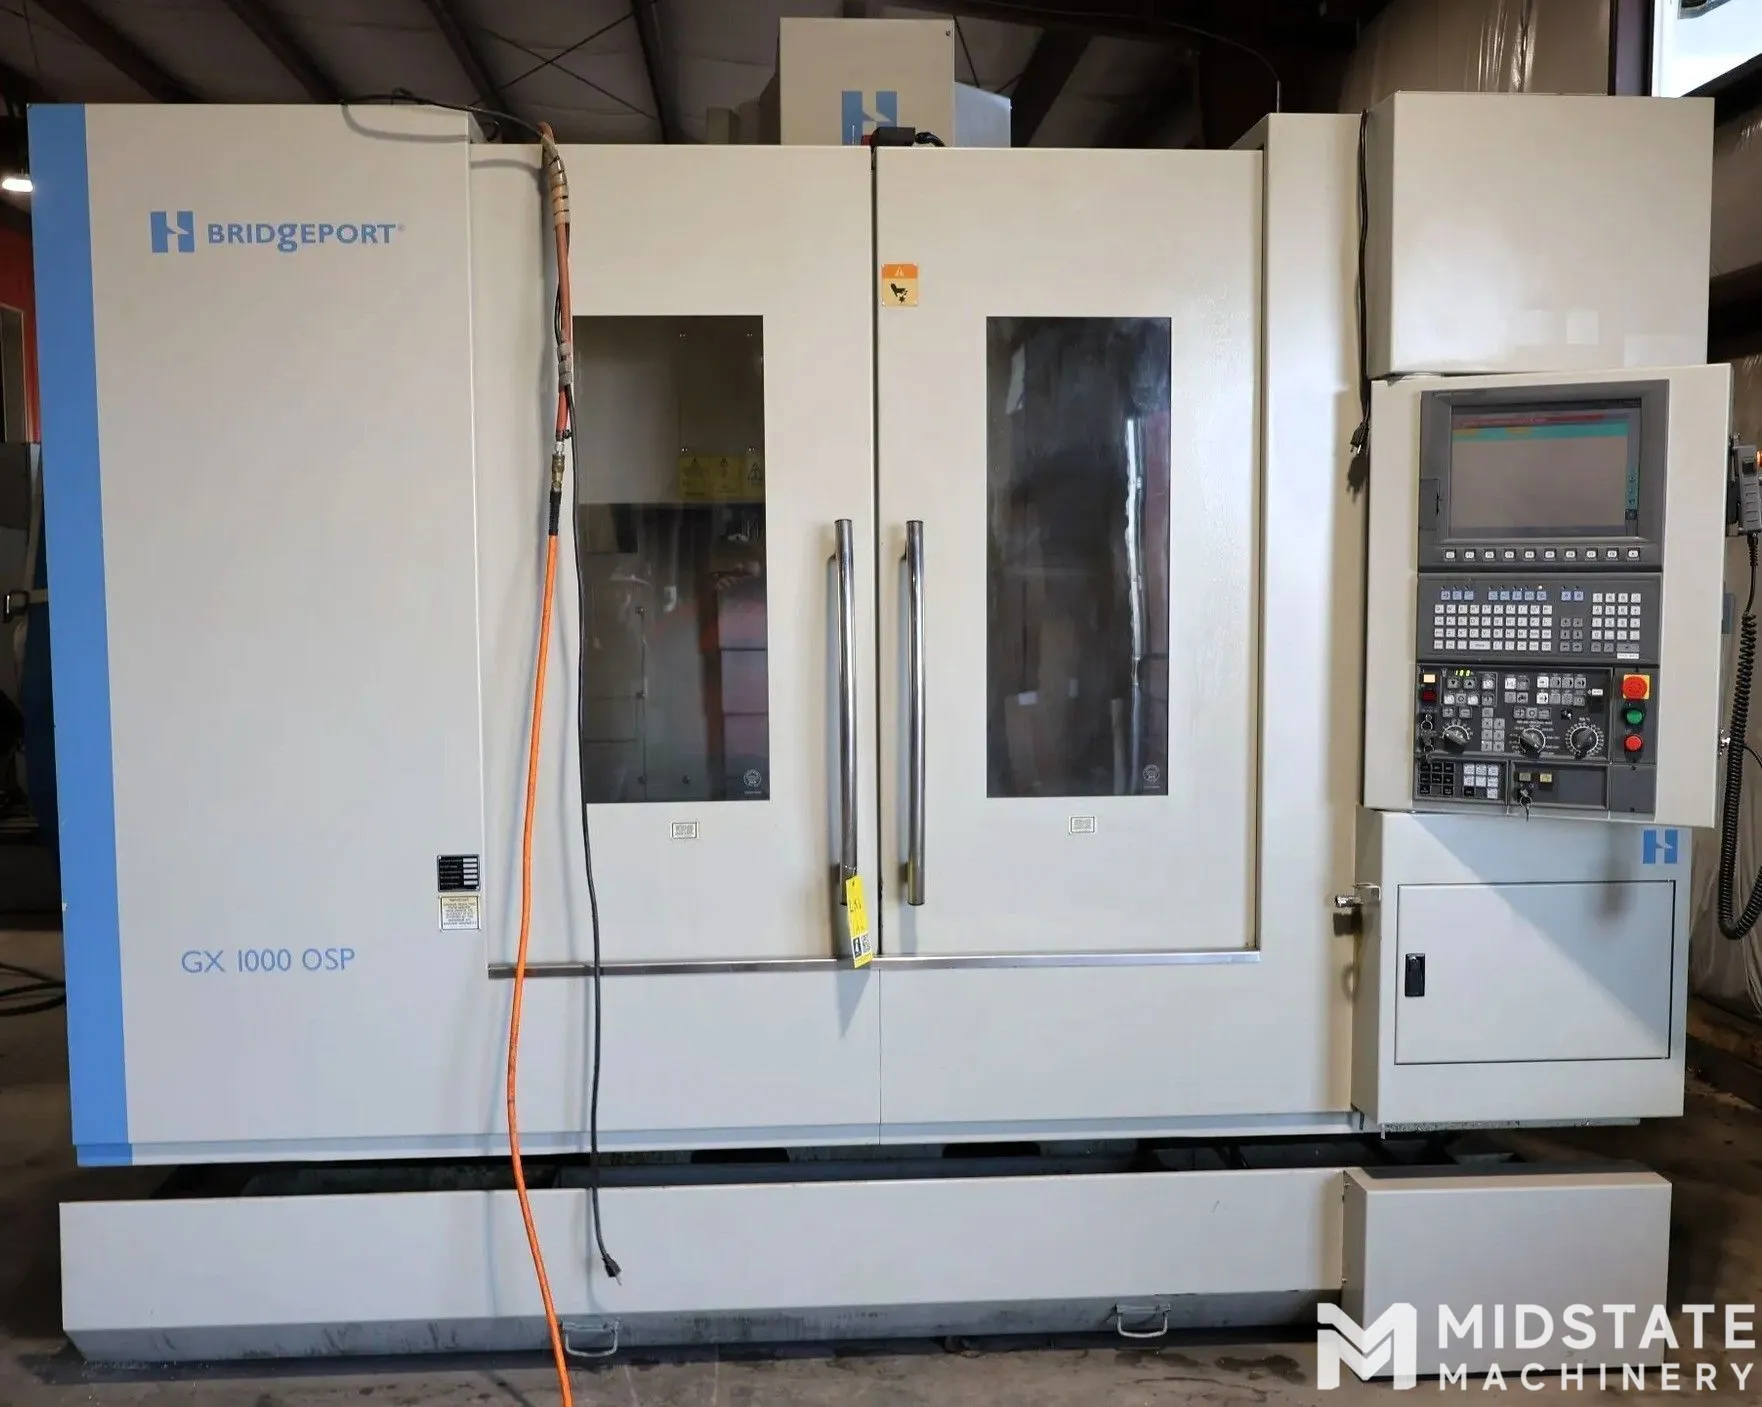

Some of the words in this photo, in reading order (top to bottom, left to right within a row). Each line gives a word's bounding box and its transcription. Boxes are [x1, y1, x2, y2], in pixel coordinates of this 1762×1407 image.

[181, 950, 226, 973] GX
[237, 948, 292, 972] 1000
[302, 948, 355, 971] OSP
